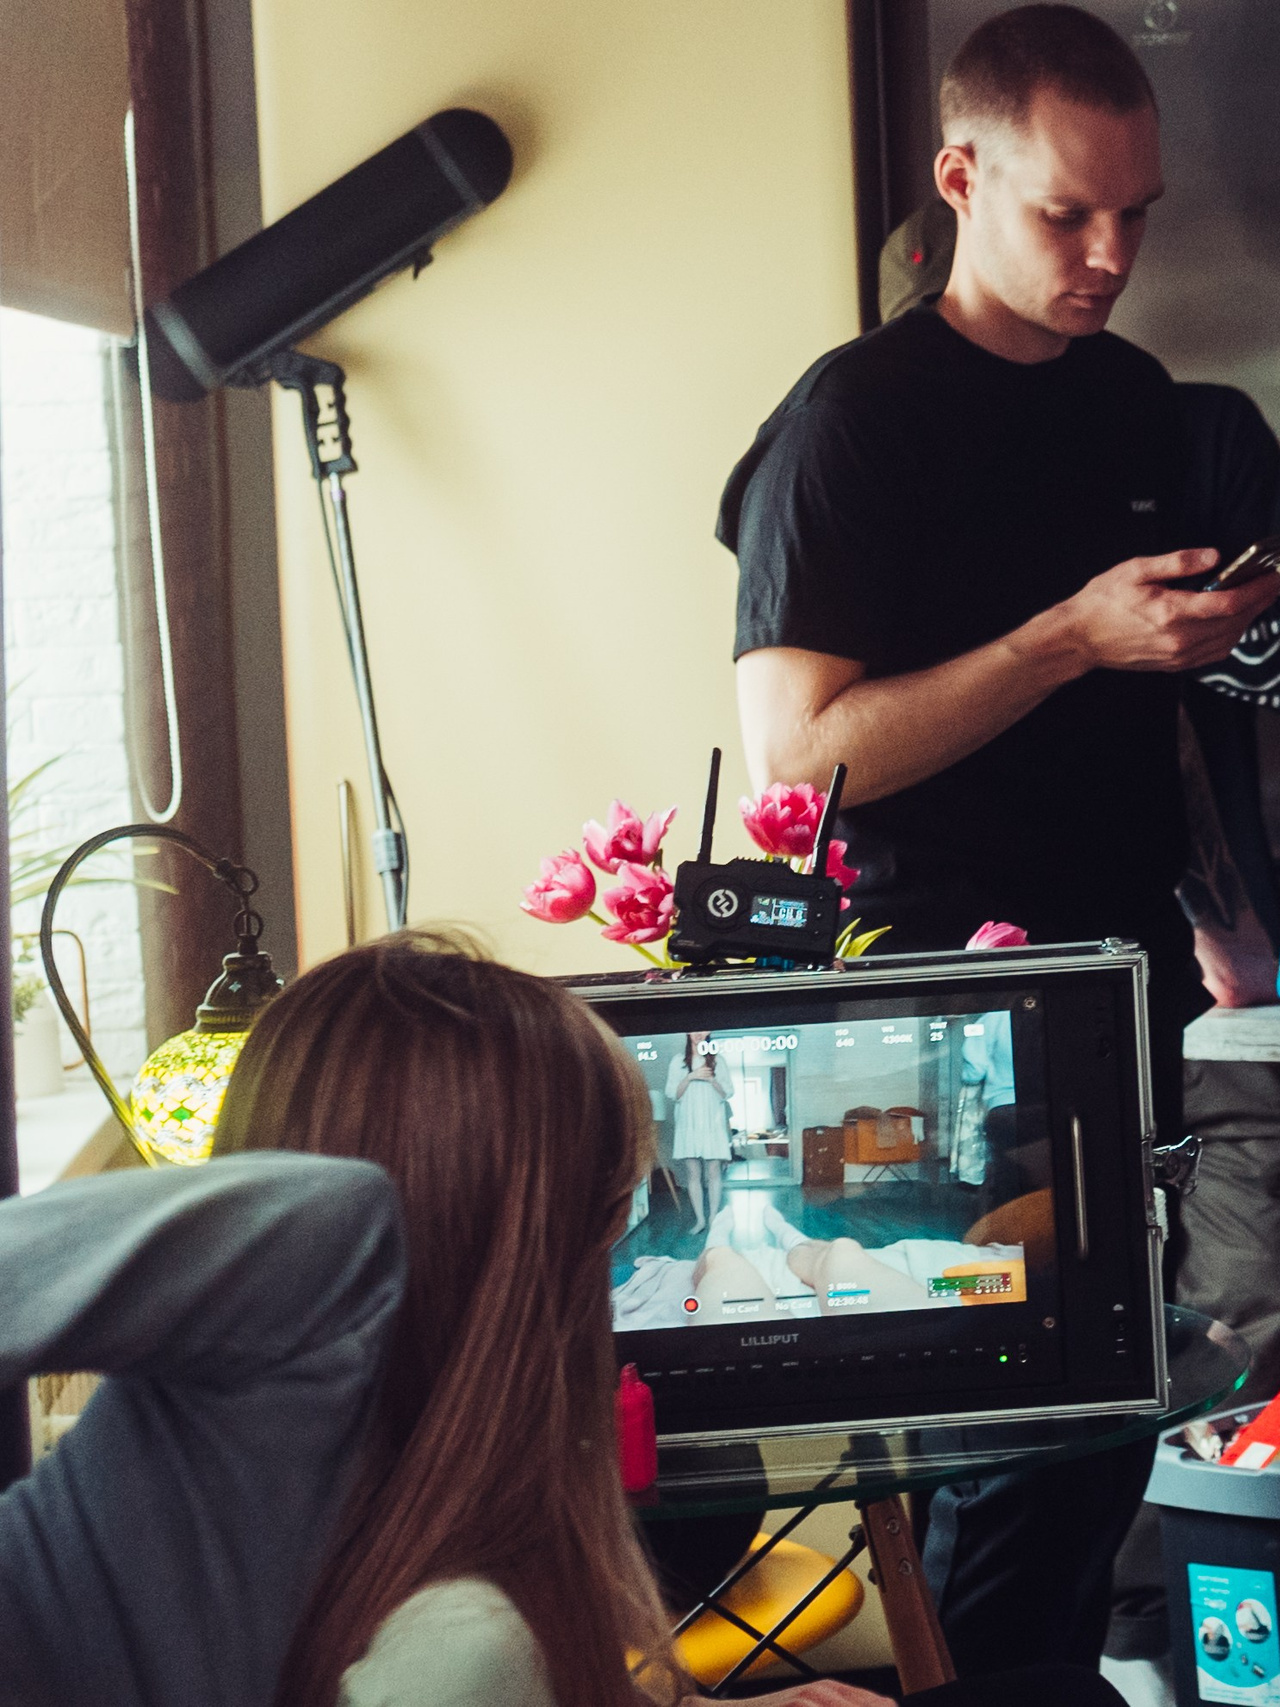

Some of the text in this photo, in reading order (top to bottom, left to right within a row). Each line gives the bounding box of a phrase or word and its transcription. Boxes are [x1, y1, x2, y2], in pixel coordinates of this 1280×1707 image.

[930, 1031, 943, 1042] 25
[722, 1304, 759, 1315] No Card
[775, 1300, 812, 1311] No Card
[741, 1333, 799, 1346] LILLIPUT
